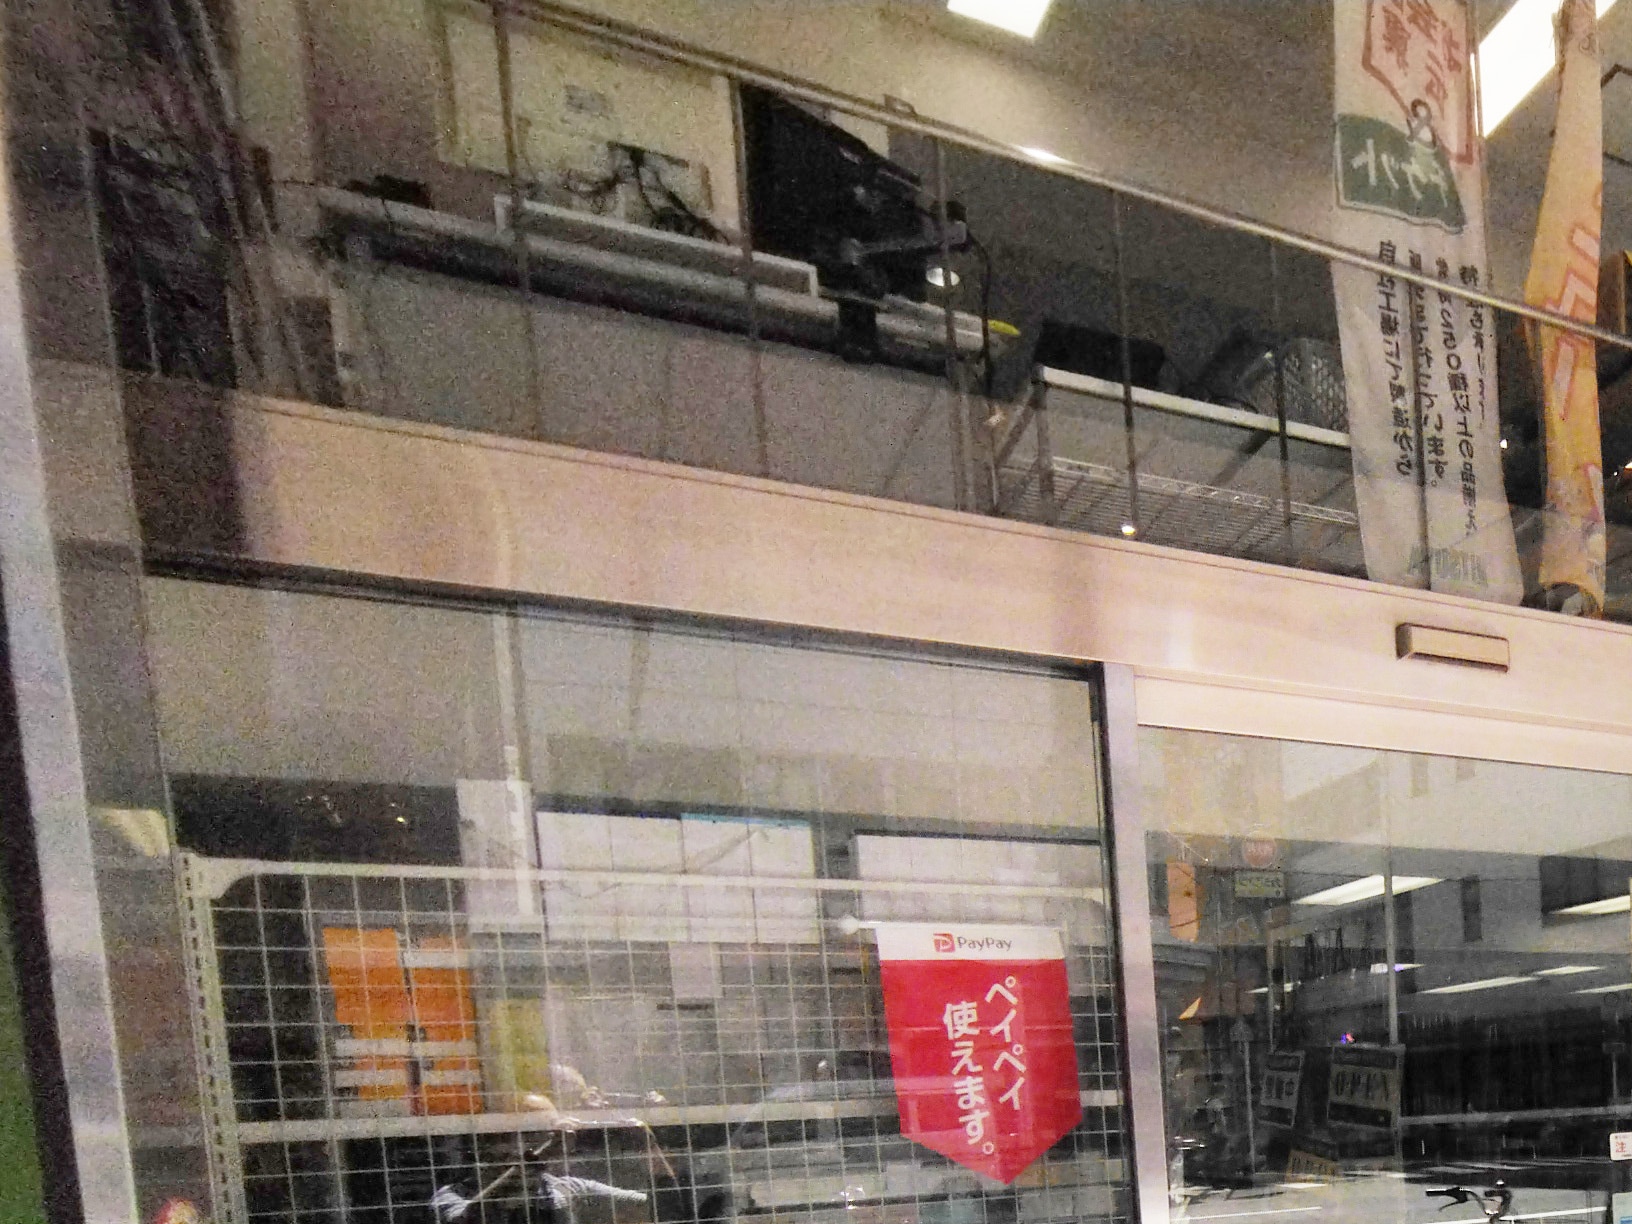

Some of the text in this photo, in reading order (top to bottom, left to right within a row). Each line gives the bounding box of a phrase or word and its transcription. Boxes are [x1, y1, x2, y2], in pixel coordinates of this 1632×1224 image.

[957, 936, 1013, 953] PayPay
[942, 1000, 995, 1155] 使えます。
[985, 975, 1027, 1111] ペイペイ
